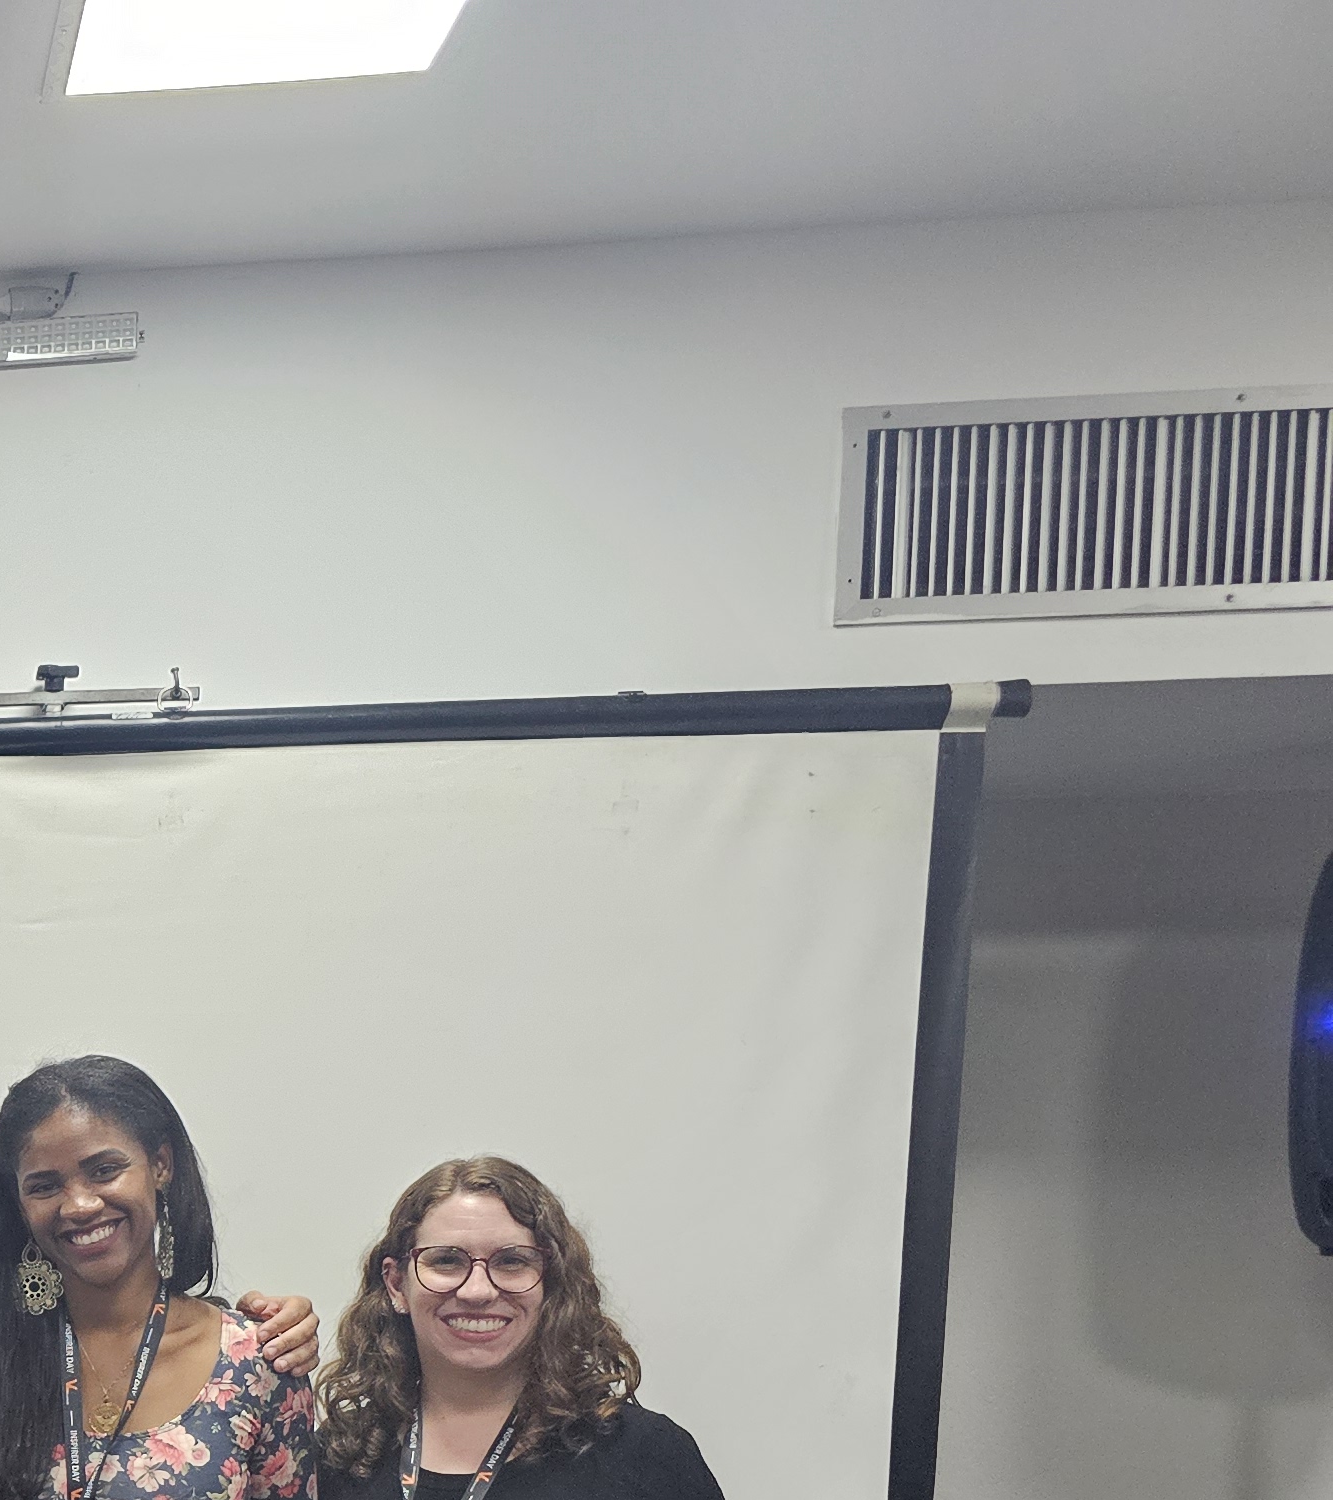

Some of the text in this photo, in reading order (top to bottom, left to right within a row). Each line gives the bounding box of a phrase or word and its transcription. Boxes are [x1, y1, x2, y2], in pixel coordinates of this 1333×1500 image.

[66, 1357, 75, 1374] DAY
[132, 1346, 150, 1397] INSPIRER DAY
[70, 1430, 80, 1483] INSPIRER DAY
[486, 1454, 499, 1469] DAY
